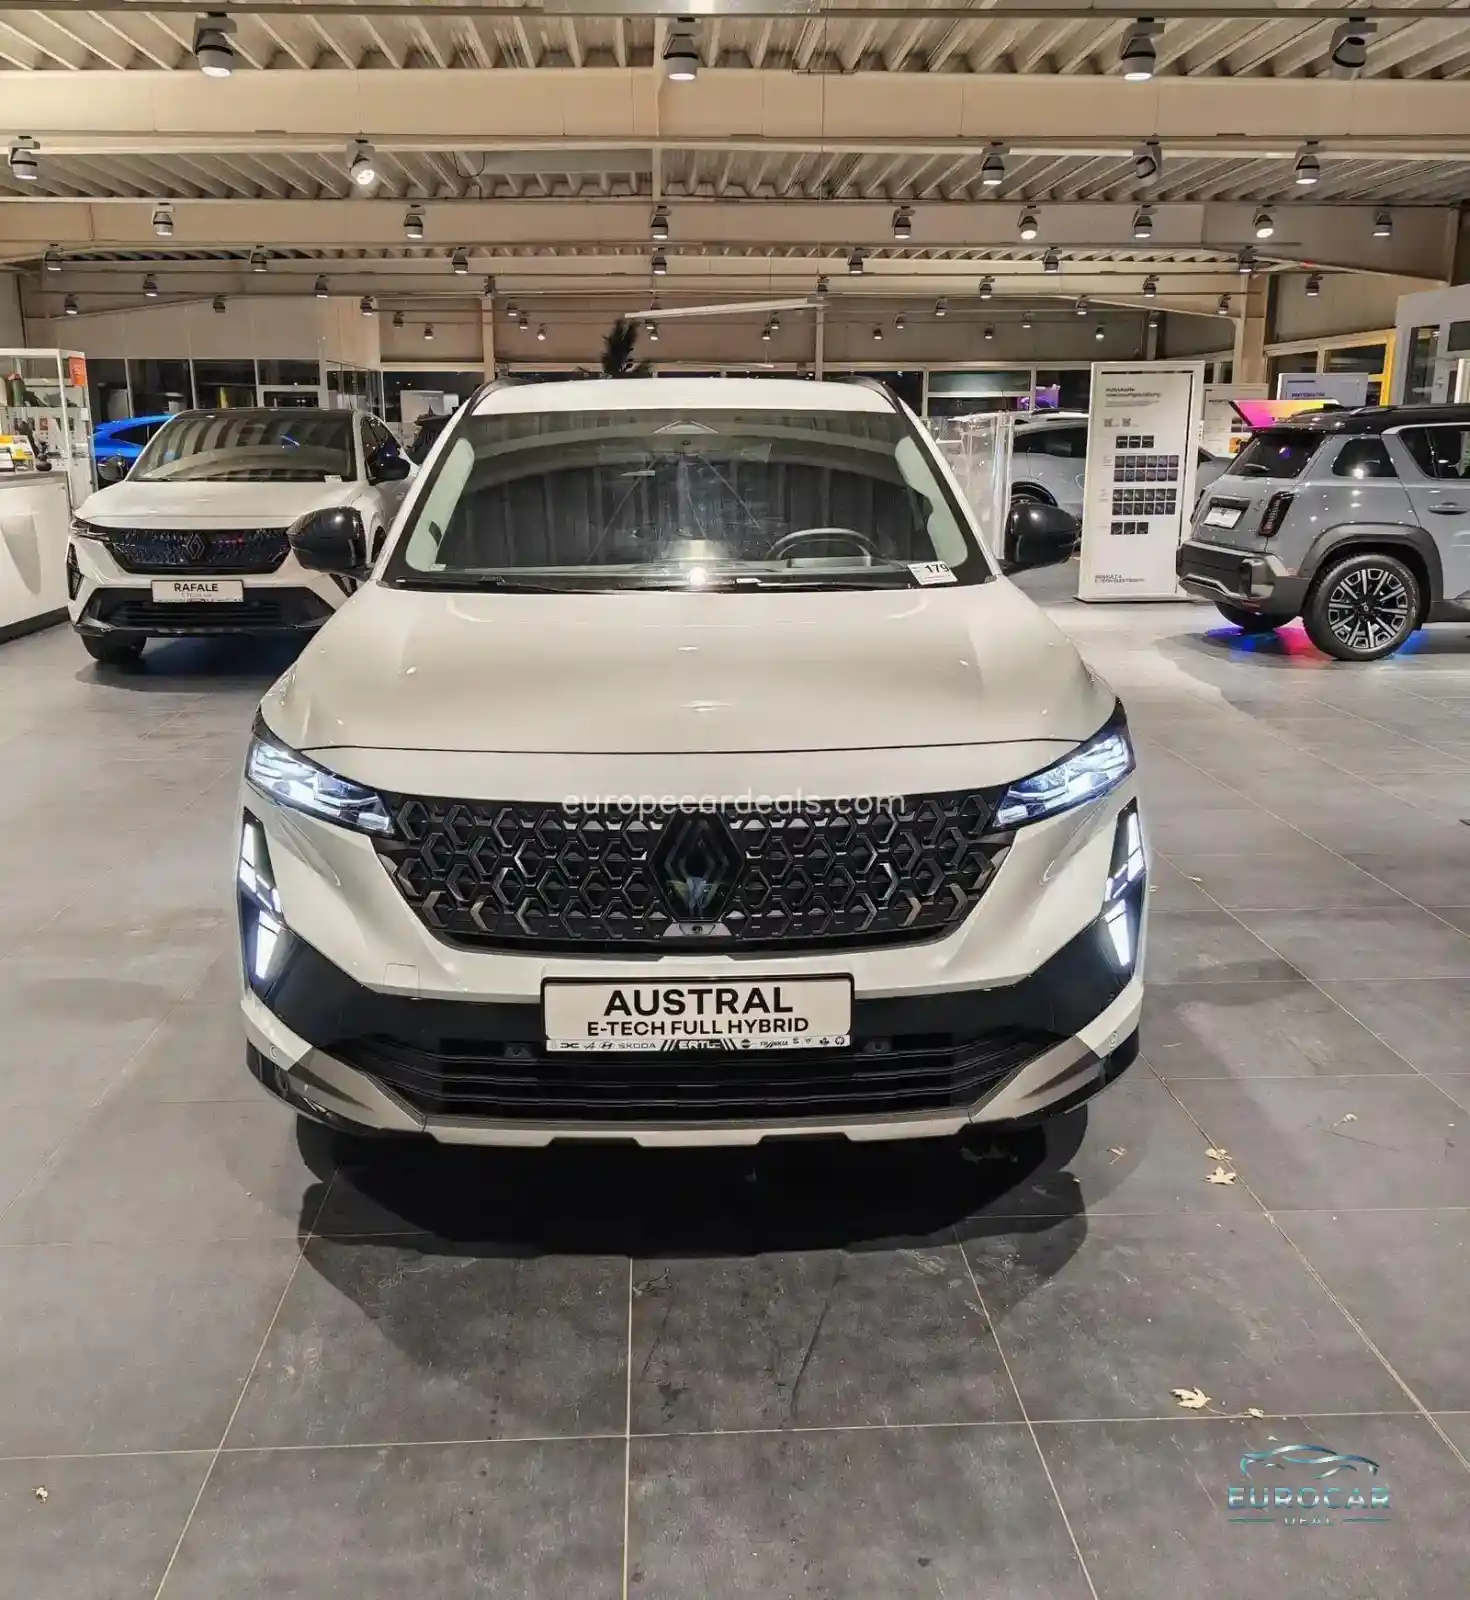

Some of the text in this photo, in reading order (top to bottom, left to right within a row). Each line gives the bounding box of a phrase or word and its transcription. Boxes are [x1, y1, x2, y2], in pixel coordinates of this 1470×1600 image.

[924, 563, 950, 573] 179
[173, 583, 219, 592] RAFALE
[603, 986, 794, 1016] AUSTRAL
[587, 1017, 809, 1037] E-TECH FULL HYBRID
